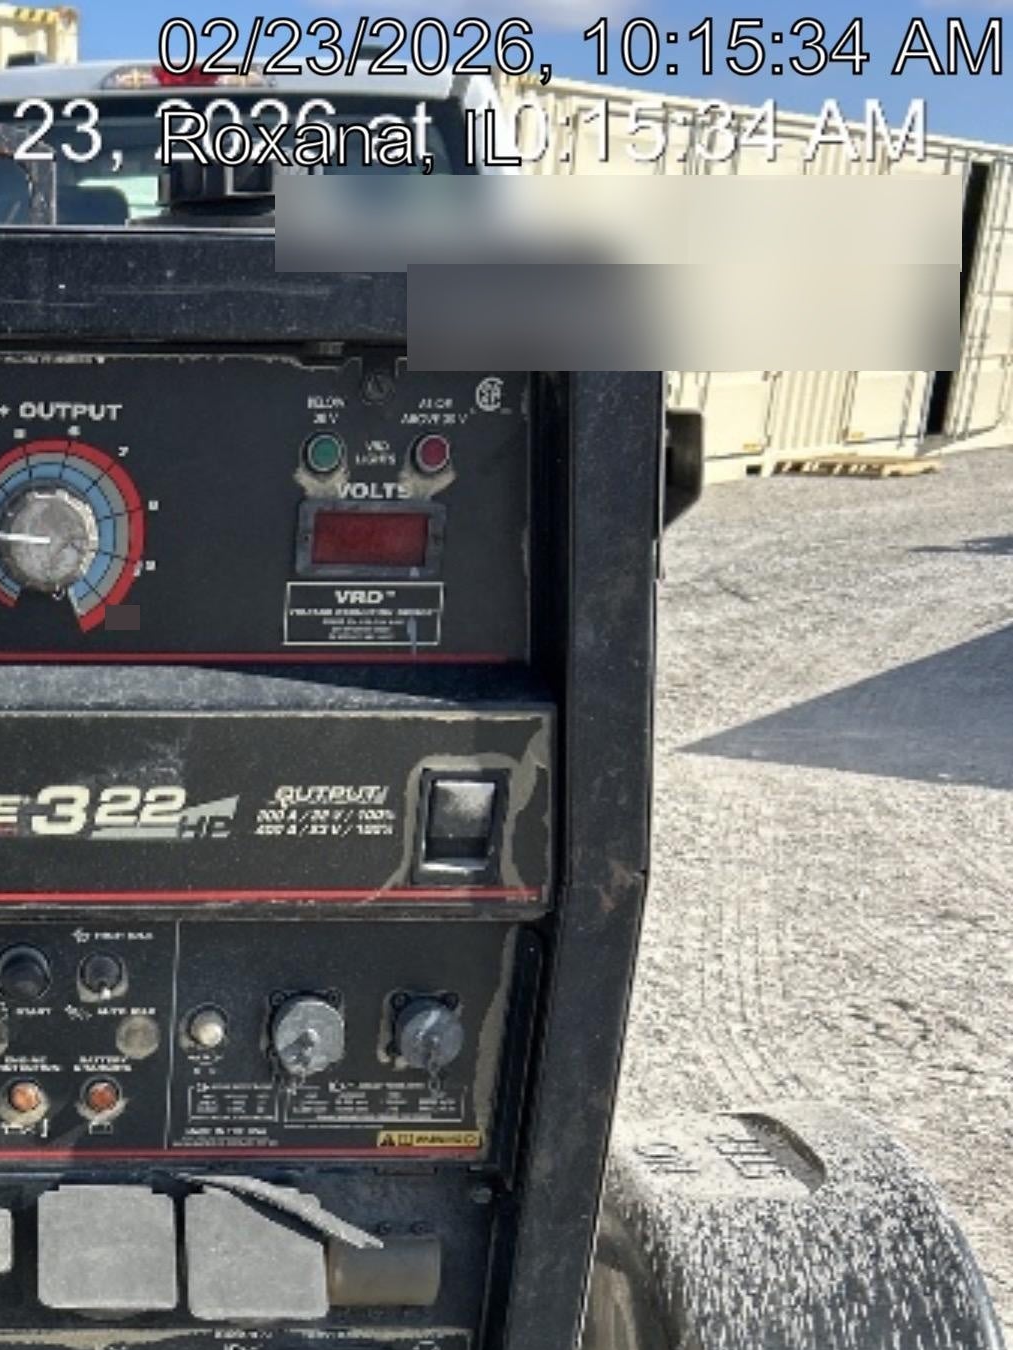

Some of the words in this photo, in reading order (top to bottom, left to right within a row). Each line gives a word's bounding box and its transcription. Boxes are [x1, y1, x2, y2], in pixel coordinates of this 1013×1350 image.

[19, 402, 123, 421] OUTPUT
[338, 482, 413, 500] VOLTS
[30, 784, 188, 836] 322
